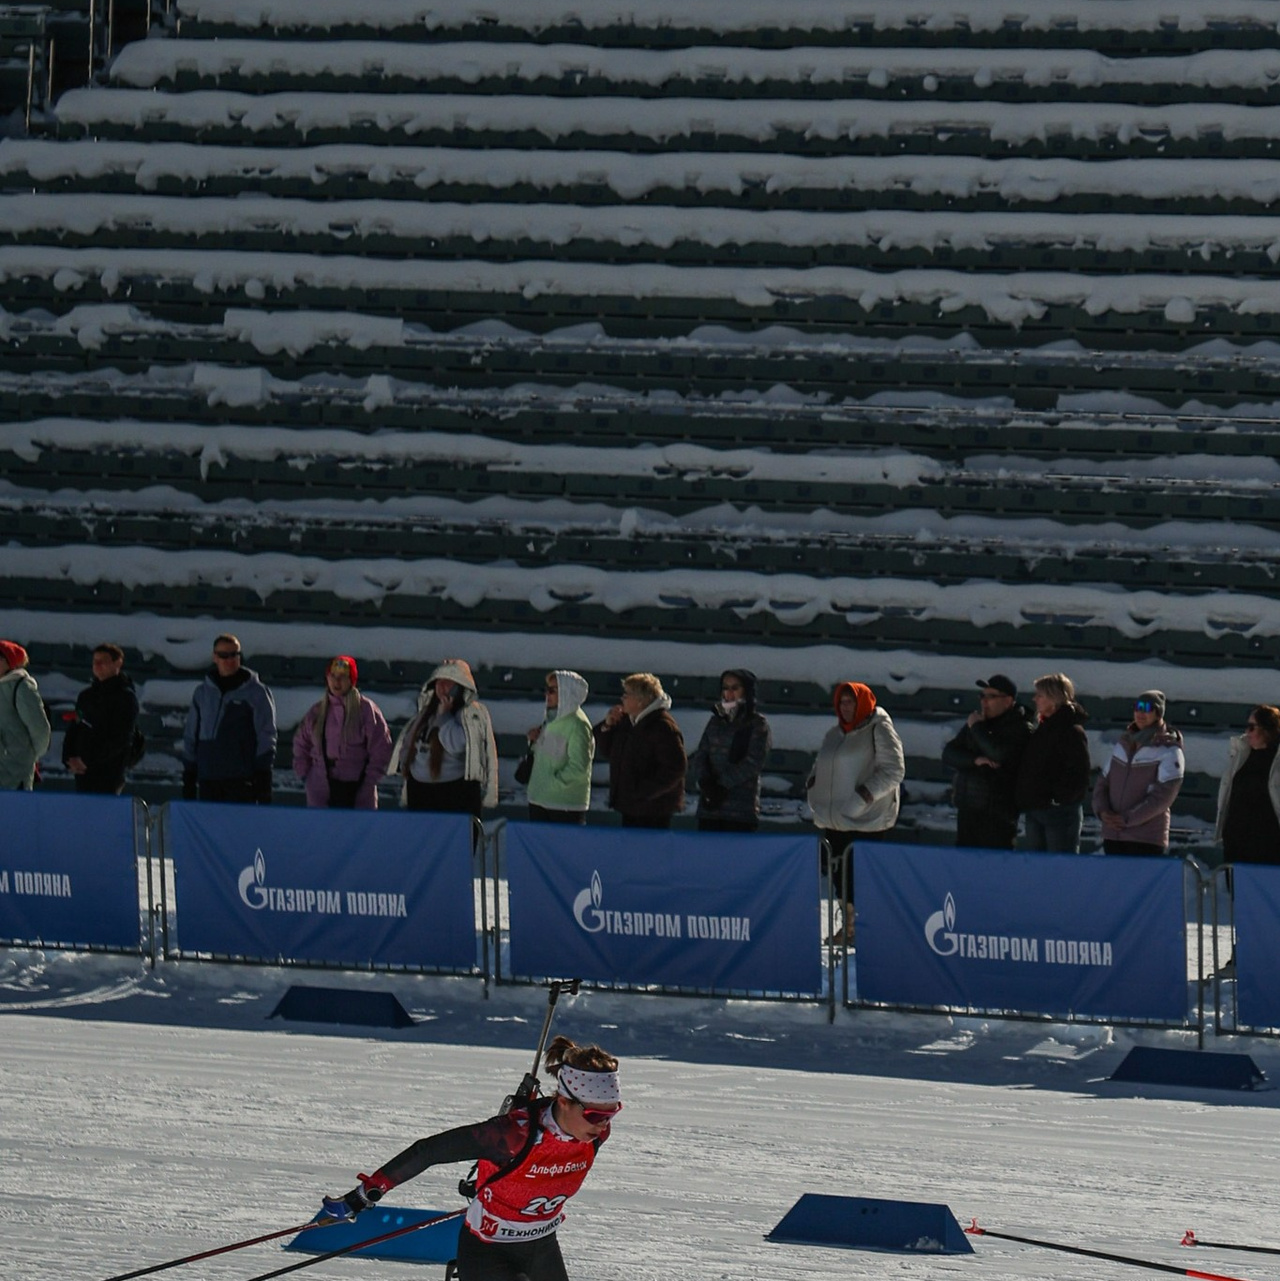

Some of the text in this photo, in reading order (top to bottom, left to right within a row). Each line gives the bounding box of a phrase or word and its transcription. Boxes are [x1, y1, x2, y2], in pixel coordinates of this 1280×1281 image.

[14, 871, 72, 897] ПОЛЯНА
[268, 887, 407, 917] ГАЗПРОМ ПОЛЯНА
[606, 910, 750, 941] ГАЗПРОМ ПОЛЯНА
[959, 934, 1112, 966] ГАЗПРОМ ПОЛЯНА
[529, 1164, 563, 1177] Альфа
